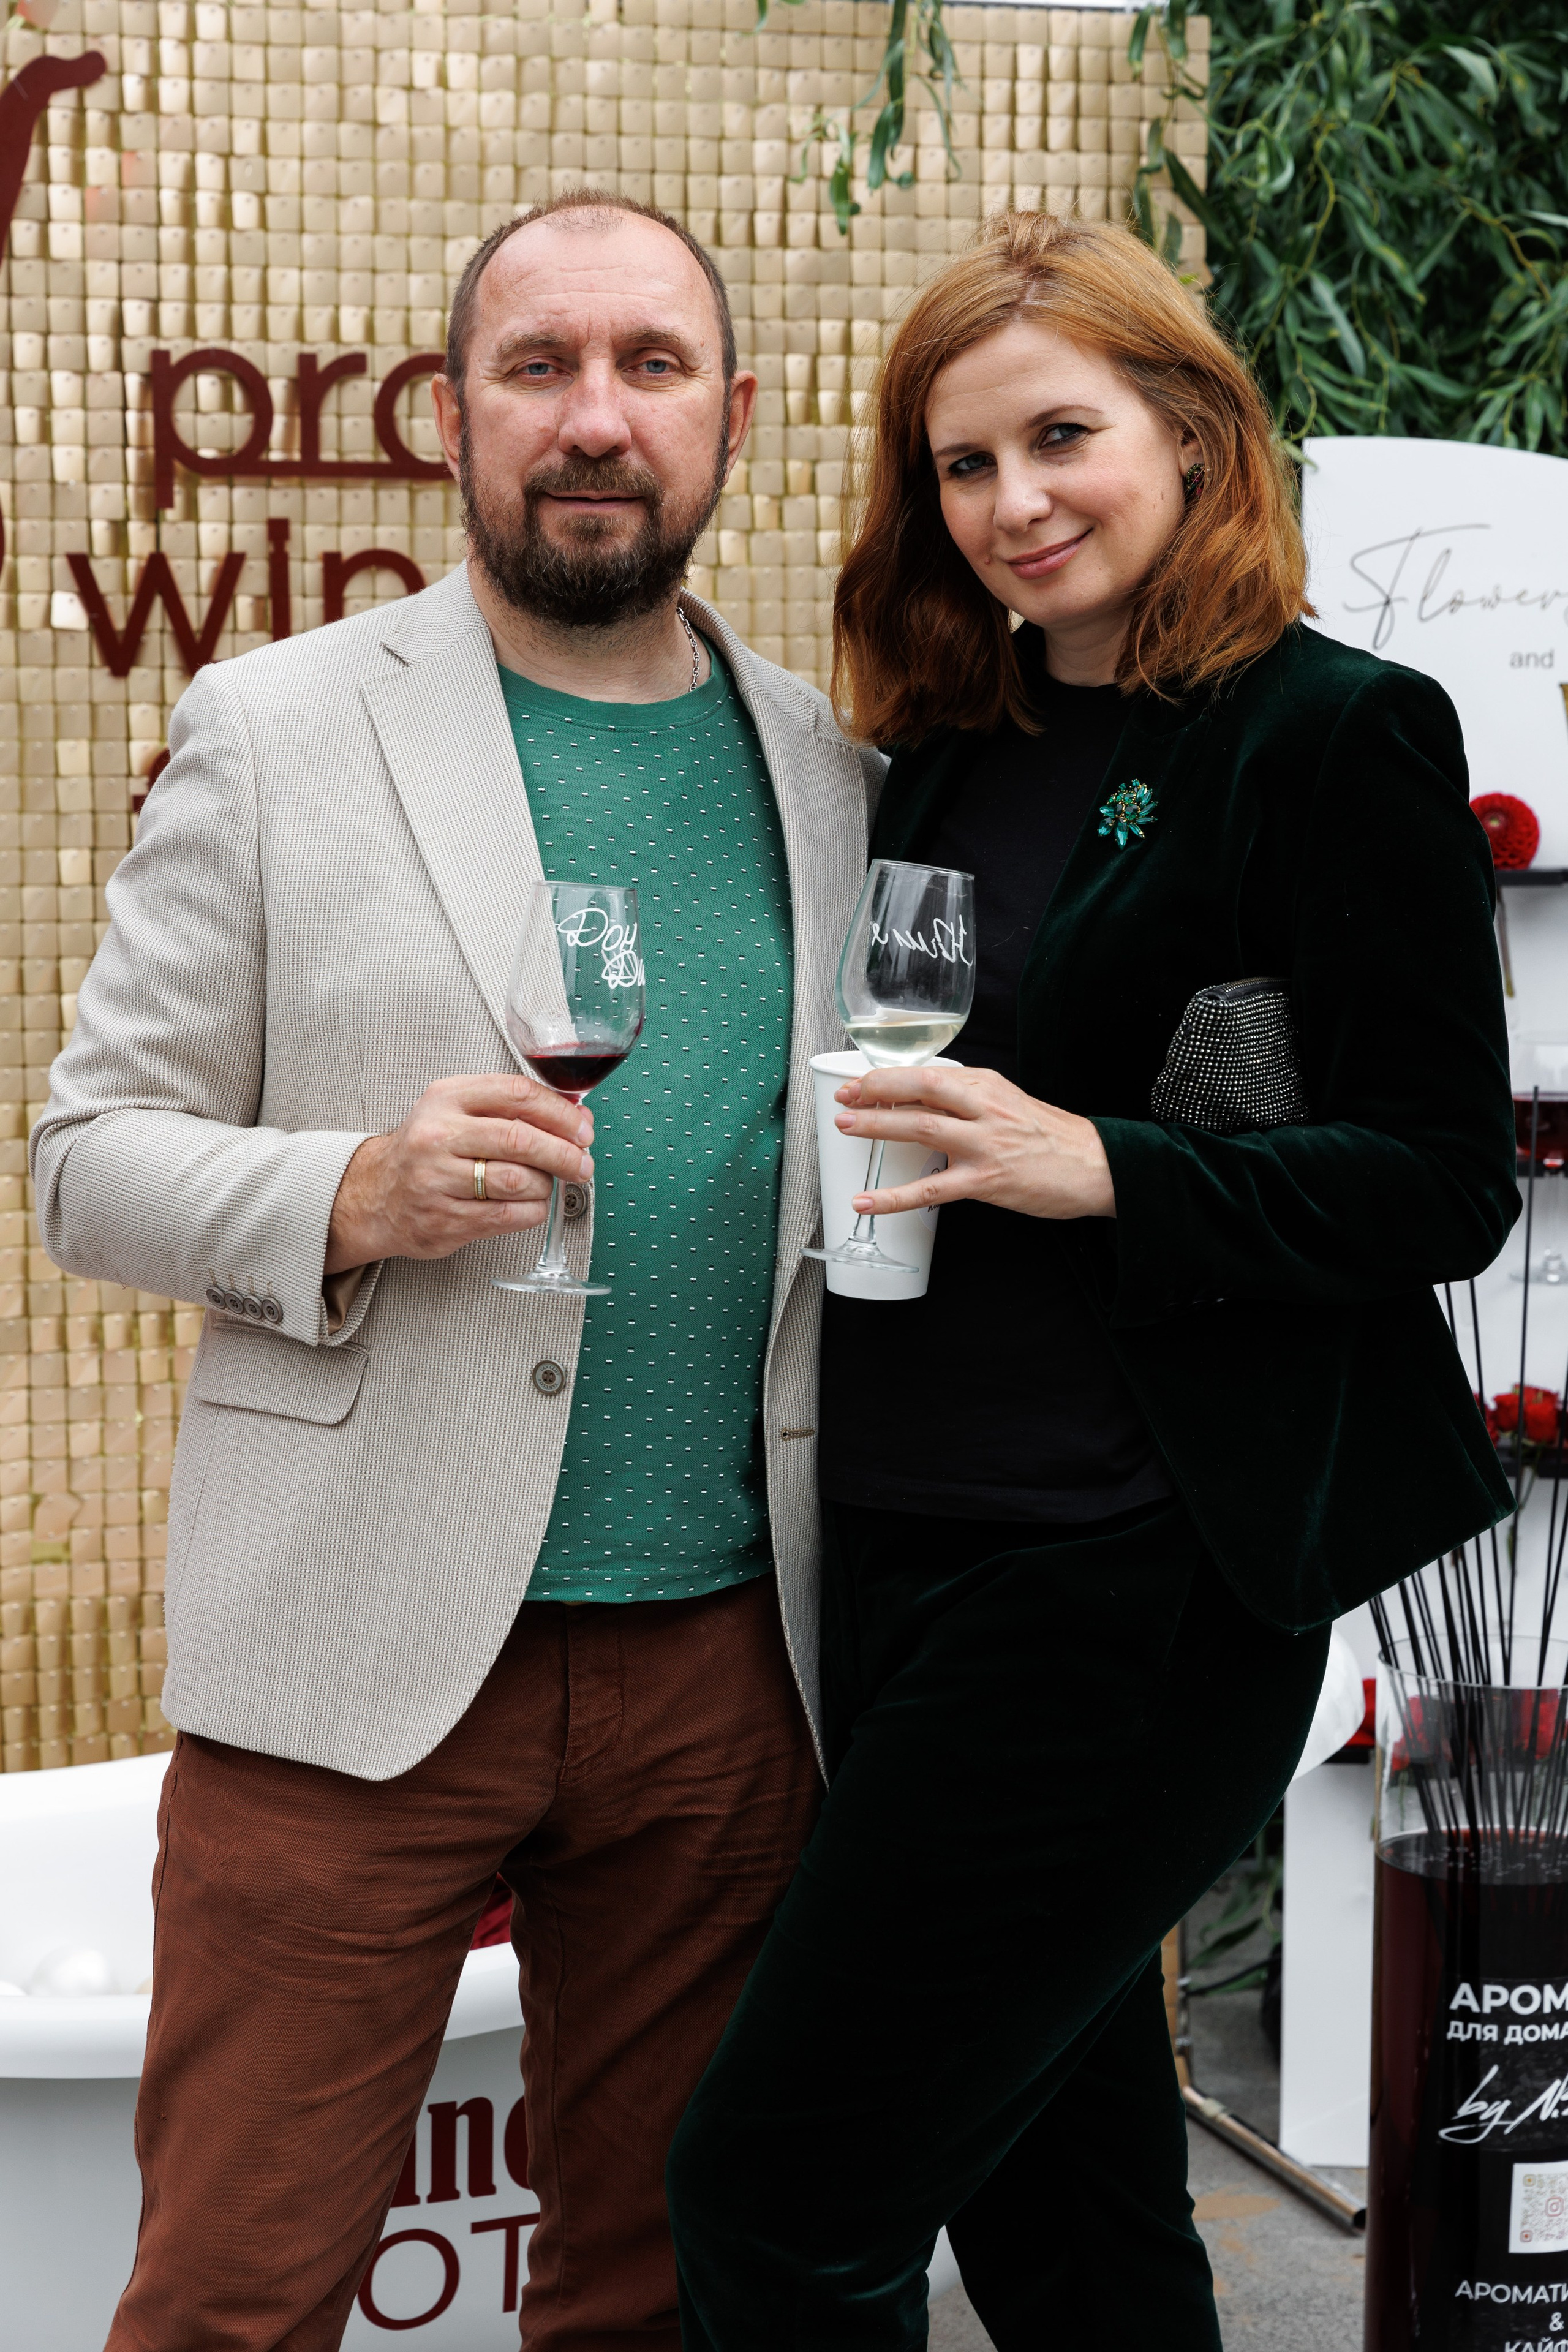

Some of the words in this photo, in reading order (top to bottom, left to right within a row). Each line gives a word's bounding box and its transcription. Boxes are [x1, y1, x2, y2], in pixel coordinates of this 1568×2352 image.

[1343, 524, 1568, 650] Flower
[1509, 648, 1555, 670] and
[1449, 1981, 1568, 2015] АРОМ
[1446, 2021, 1499, 2043] ДЛЯ
[1438, 2064, 1512, 2144] by
[1549, 2312, 1564, 2332] &
